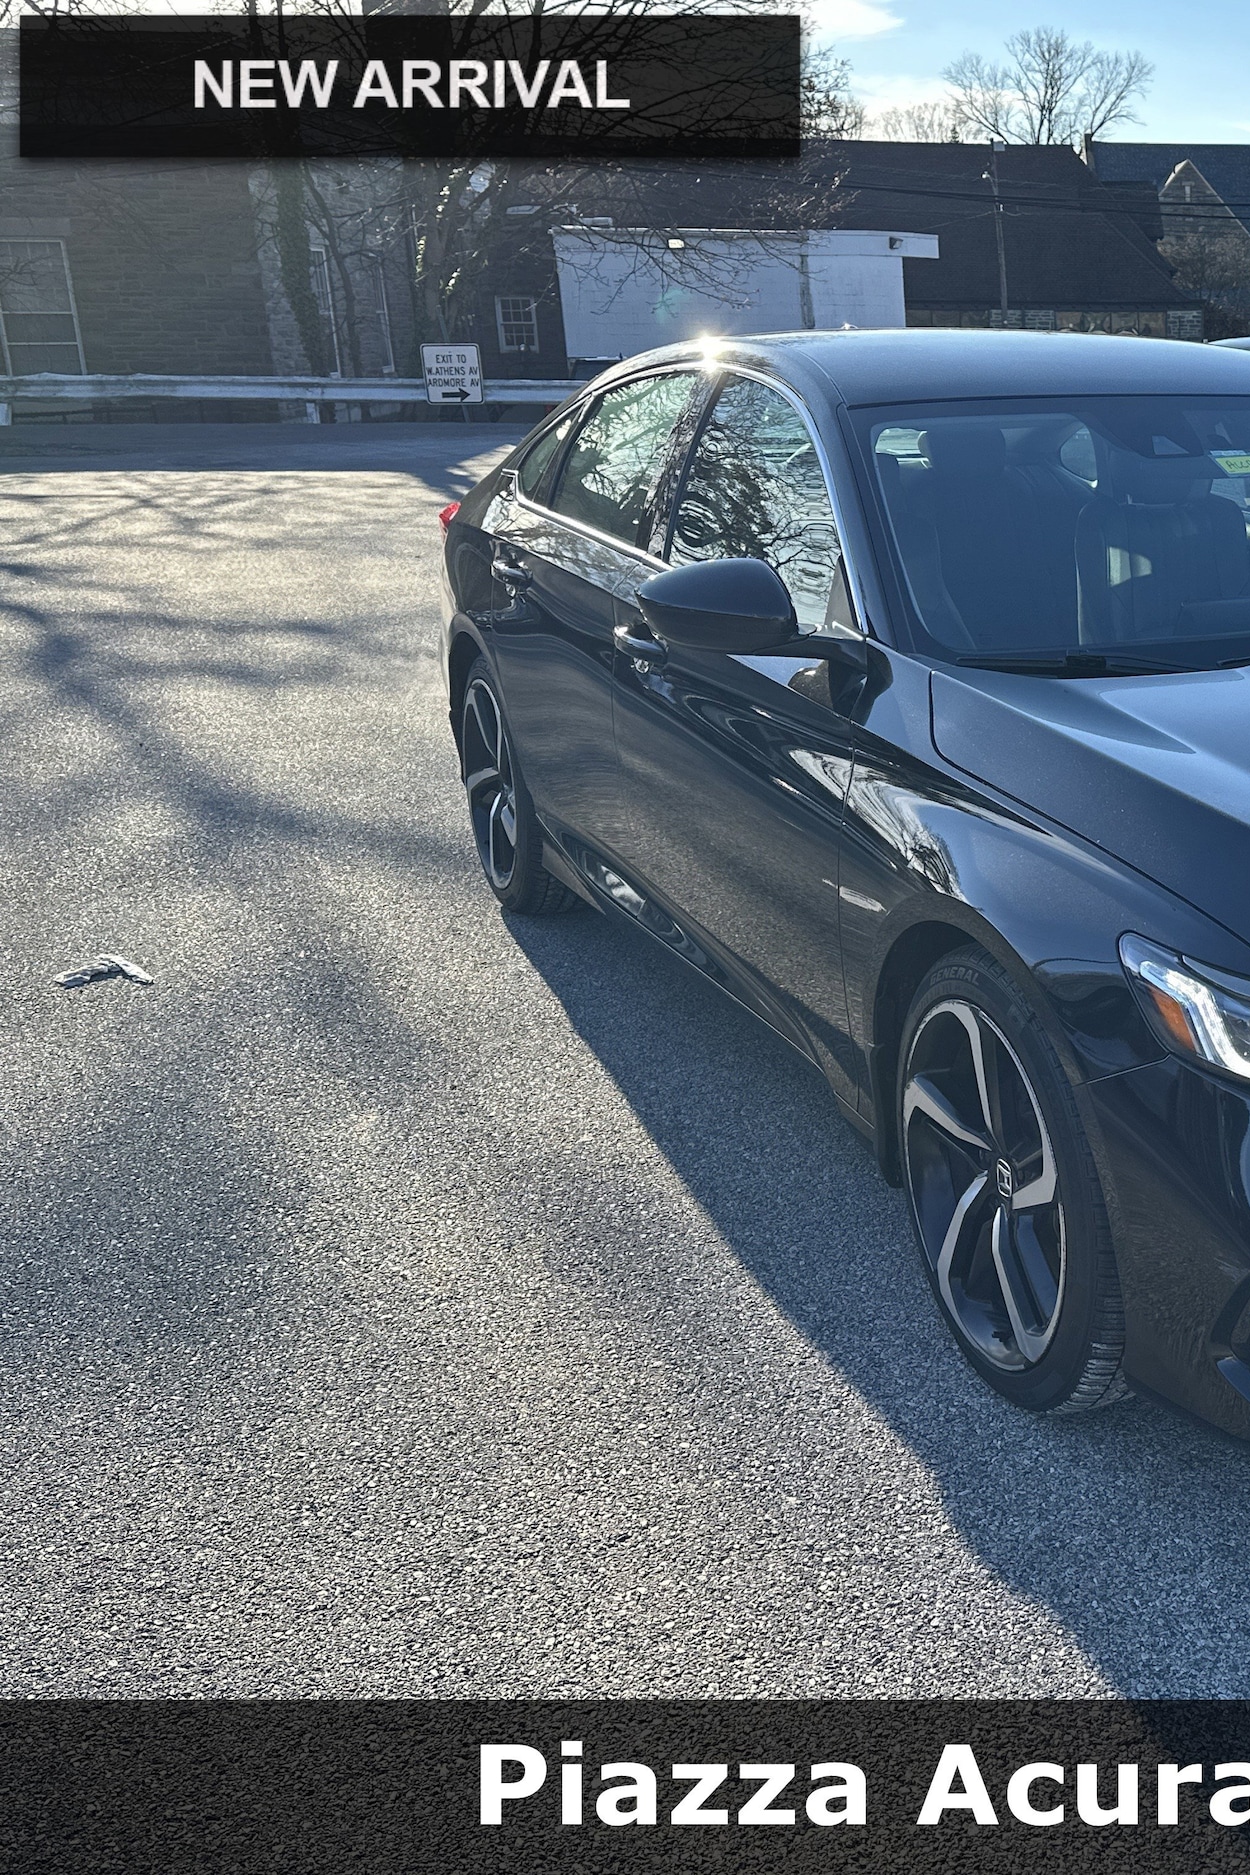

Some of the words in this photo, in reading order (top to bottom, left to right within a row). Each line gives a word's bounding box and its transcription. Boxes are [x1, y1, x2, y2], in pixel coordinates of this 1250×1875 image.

[435, 354, 453, 364] EXIT
[456, 354, 467, 364] TO
[425, 366, 466, 376] W.ATHENS
[468, 366, 479, 375] AV
[427, 378, 467, 388] ARDMORE
[470, 378, 480, 388] AV
[930, 966, 980, 986] GENERAL
